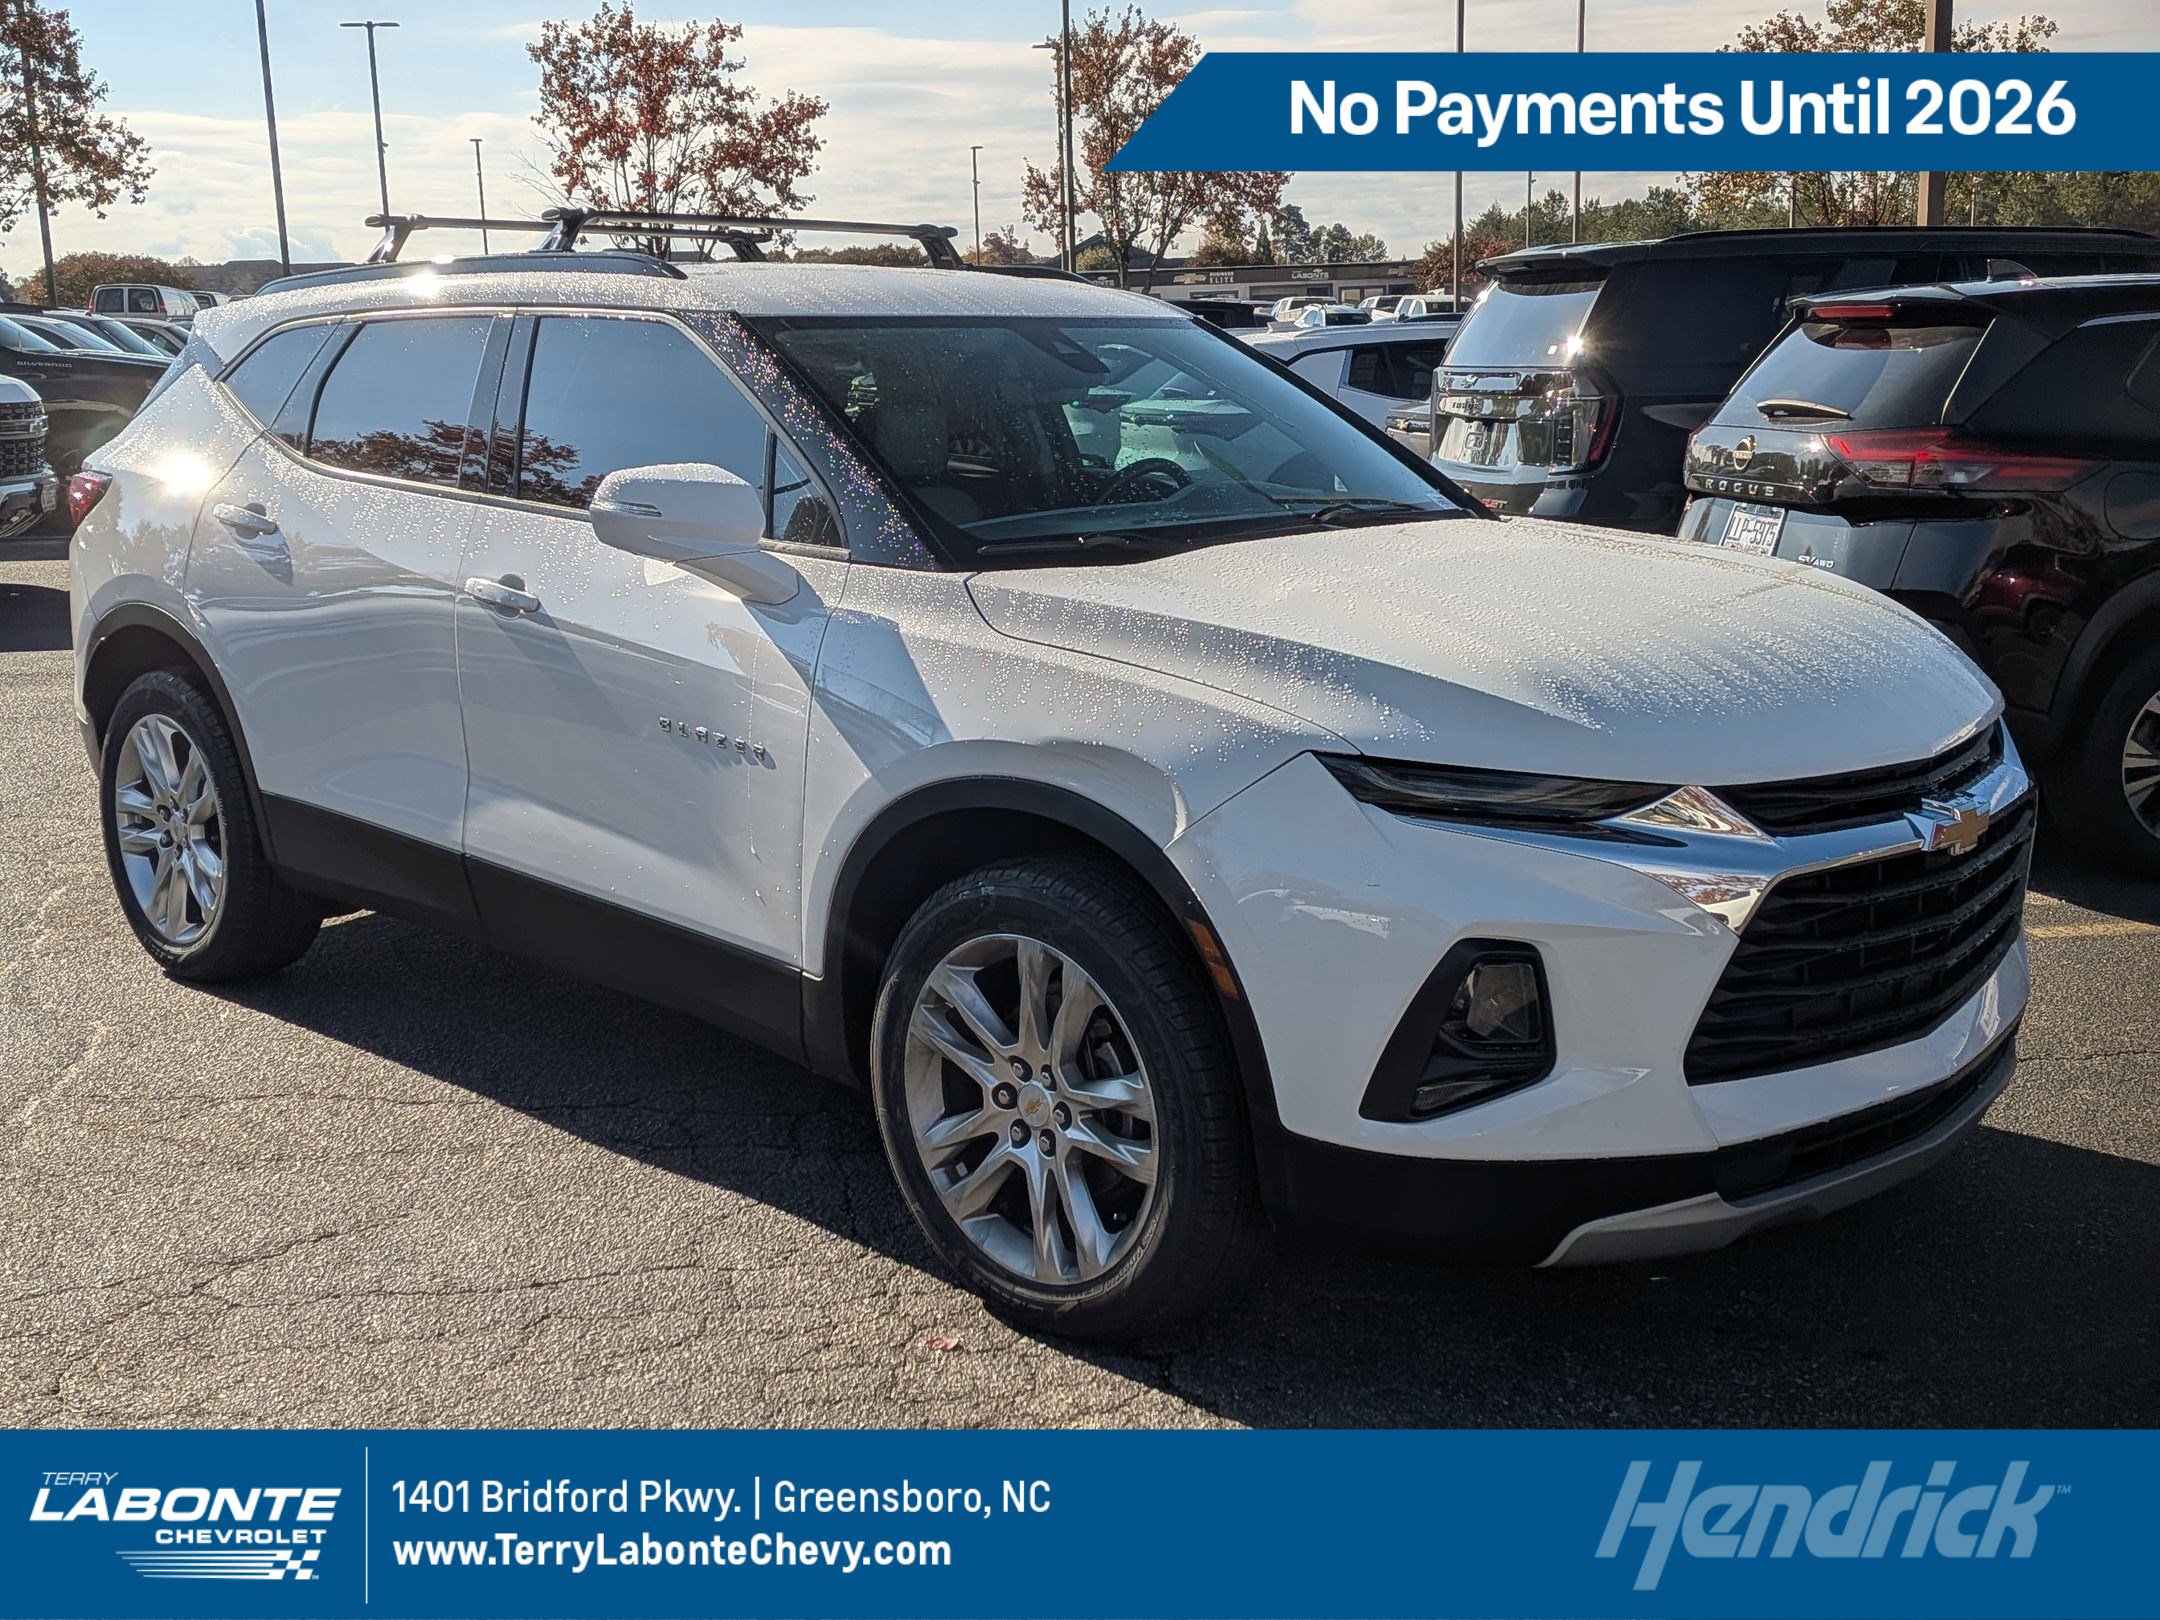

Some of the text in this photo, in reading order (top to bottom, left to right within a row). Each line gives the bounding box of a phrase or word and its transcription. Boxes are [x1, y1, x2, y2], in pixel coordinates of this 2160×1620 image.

[1209, 276, 1234, 284] ELITE
[16, 360, 73, 369] SILVERADO
[1704, 478, 1775, 497] ROGUE
[1812, 559, 1835, 569] AWD
[659, 716, 766, 761] BLAZER
